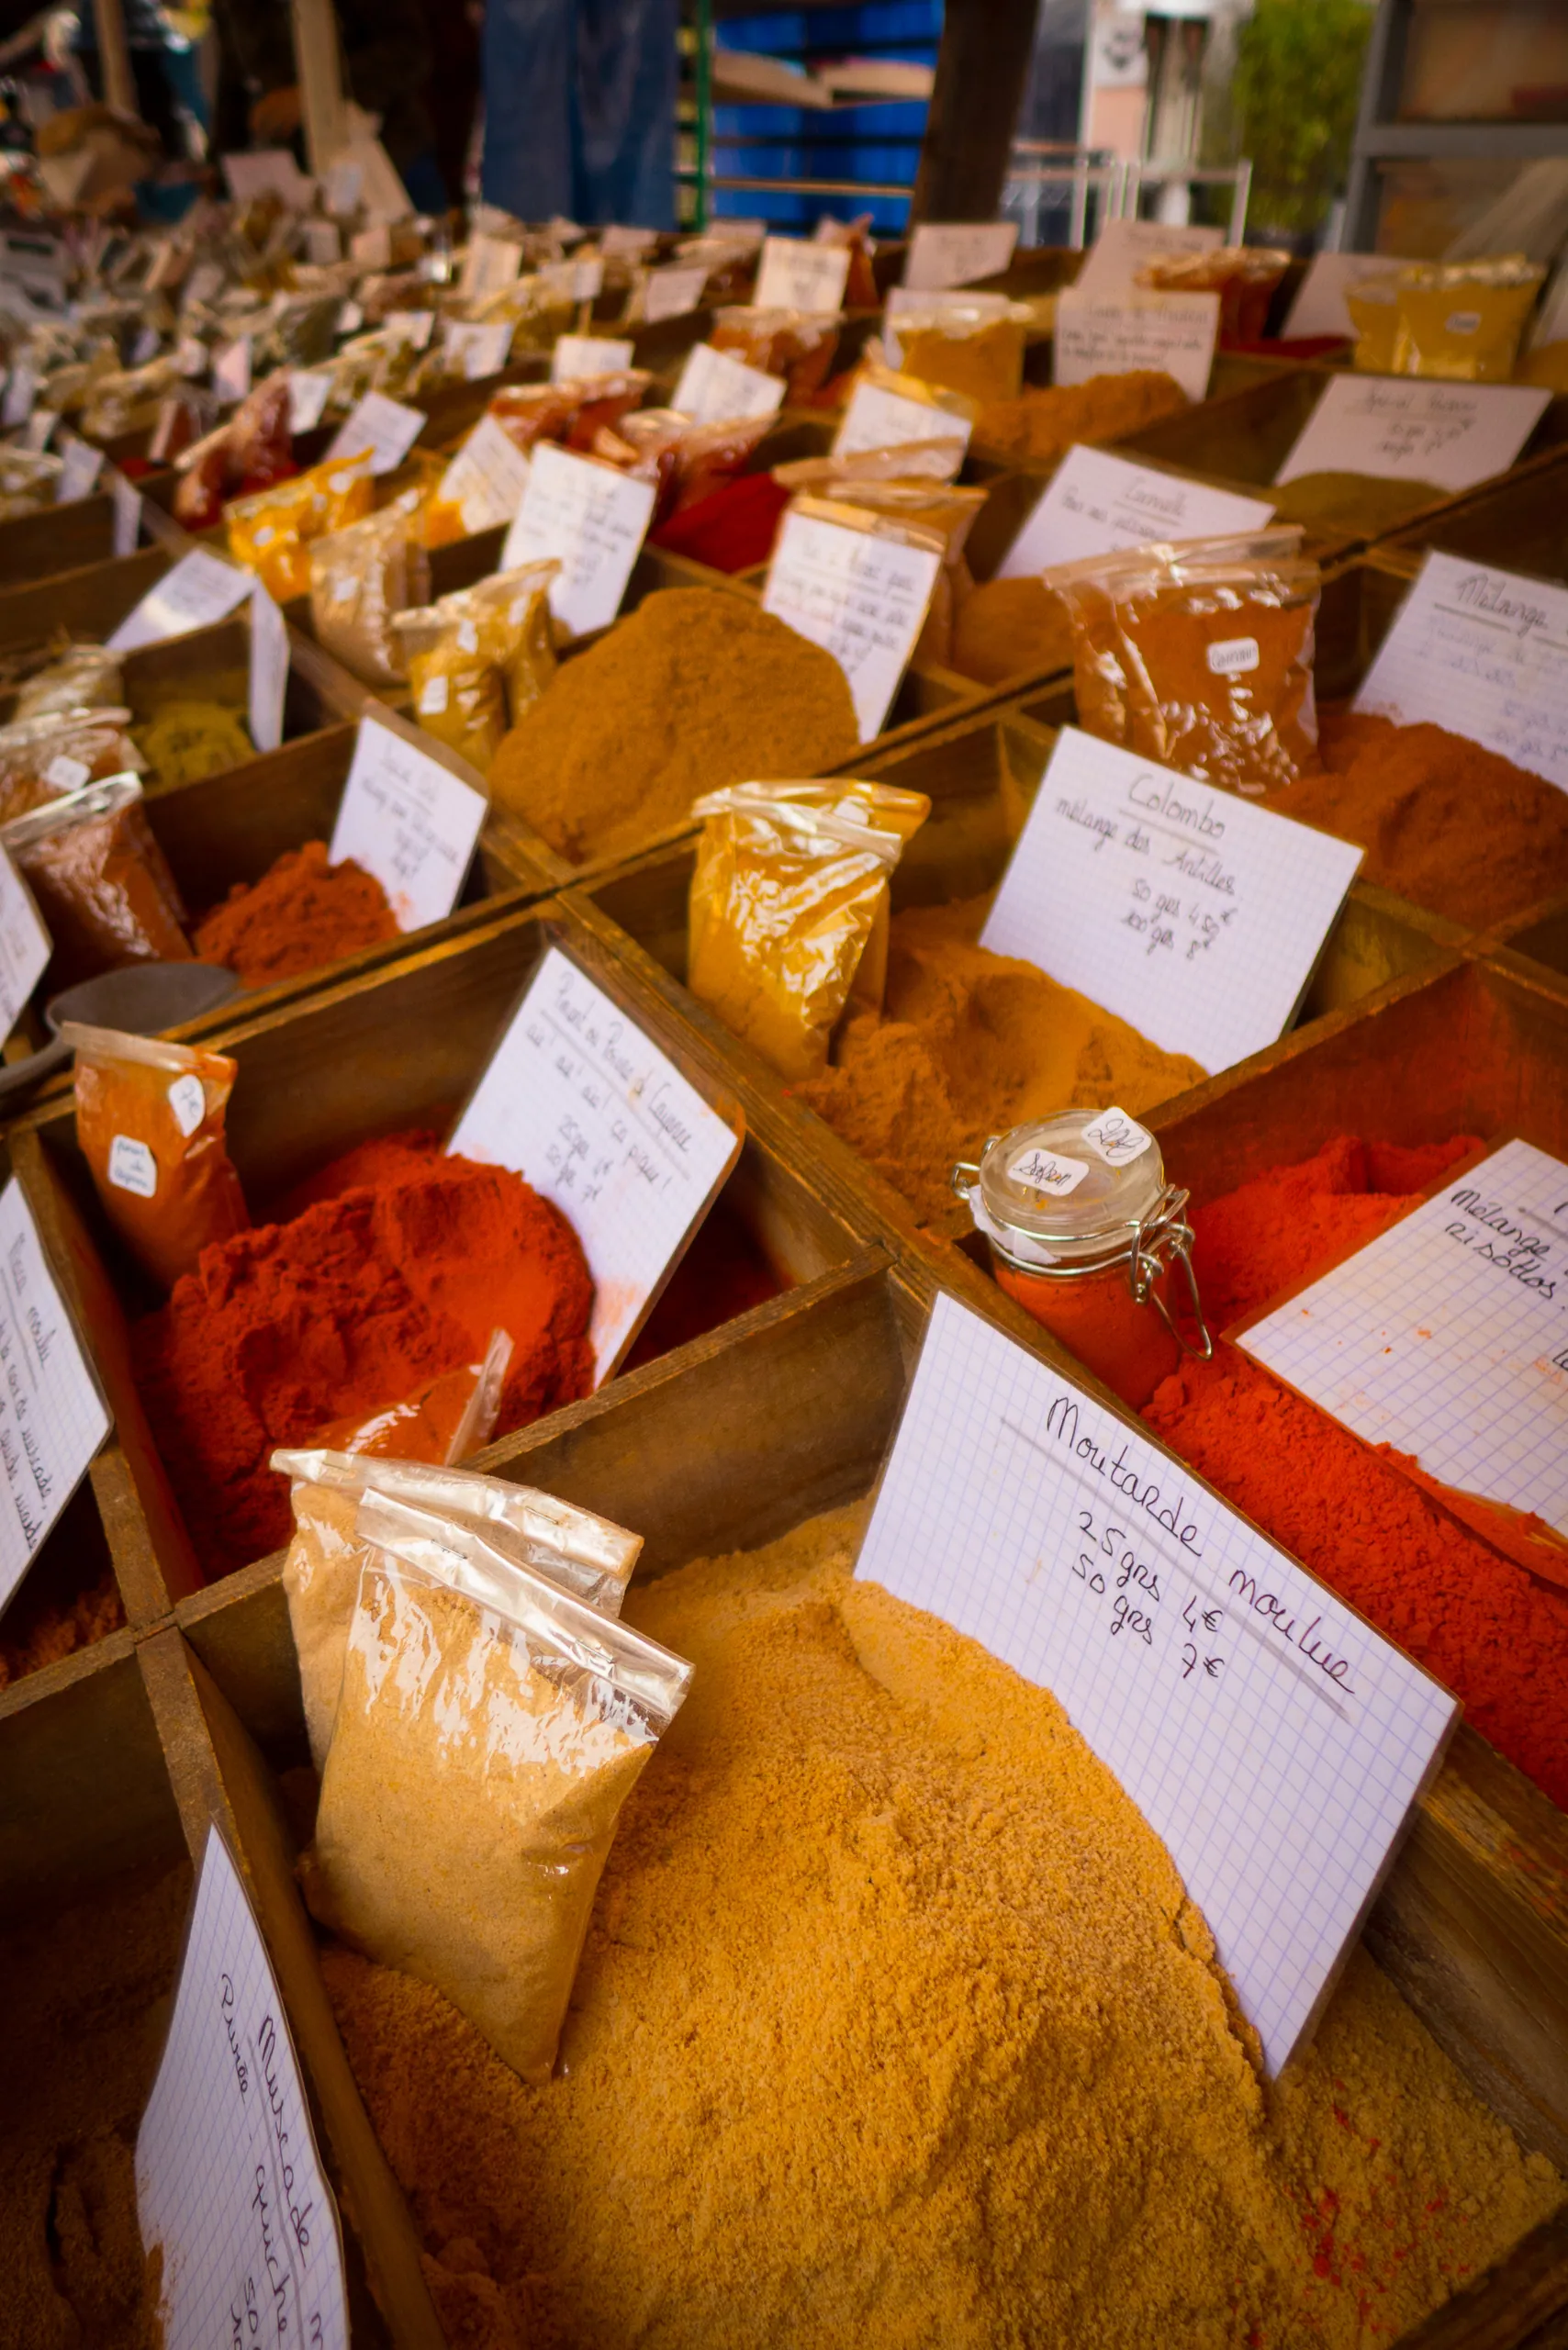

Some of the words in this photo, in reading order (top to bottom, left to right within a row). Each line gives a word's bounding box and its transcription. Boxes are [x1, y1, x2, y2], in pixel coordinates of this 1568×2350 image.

[1127, 773, 1226, 839] Colombo
[1450, 1189, 1551, 1262] Mélange
[1047, 1396, 1202, 1557] Moutarde
[1228, 1570, 1355, 1695] moulue
[1072, 1553, 1105, 1594] 50
[258, 2014, 313, 2268] Muscade
